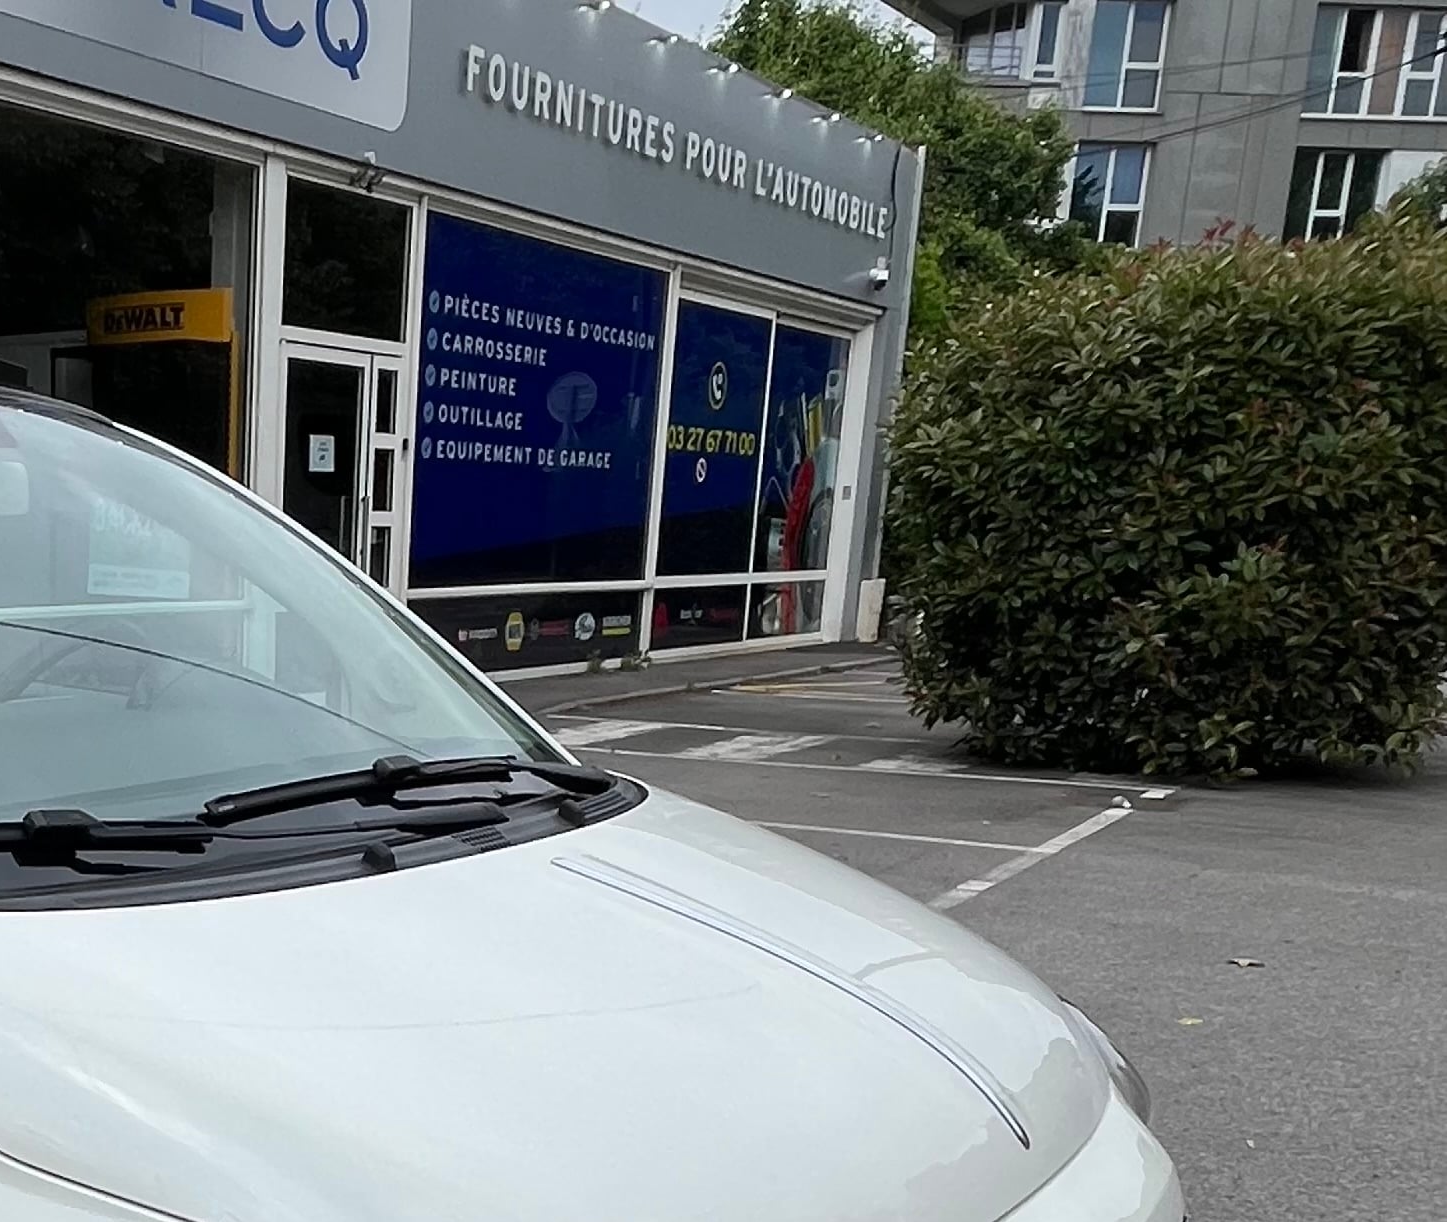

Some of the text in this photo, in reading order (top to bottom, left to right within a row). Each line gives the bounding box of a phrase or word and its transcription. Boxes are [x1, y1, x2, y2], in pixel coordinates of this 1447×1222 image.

[465, 43, 889, 239] FOURNITURES POUR L'AUTOMOBILE
[444, 293, 655, 351] PIÈCES NEUVES & D'OCCASION
[441, 331, 547, 367] CARROSSERIE
[440, 367, 517, 397] PEINTURE
[438, 404, 523, 431] OUTILLAGE
[436, 439, 612, 469] EQUIPEMENT DE GARAGE
[668, 424, 685, 450] 03
[687, 427, 705, 452] 27
[738, 432, 756, 456] 00
